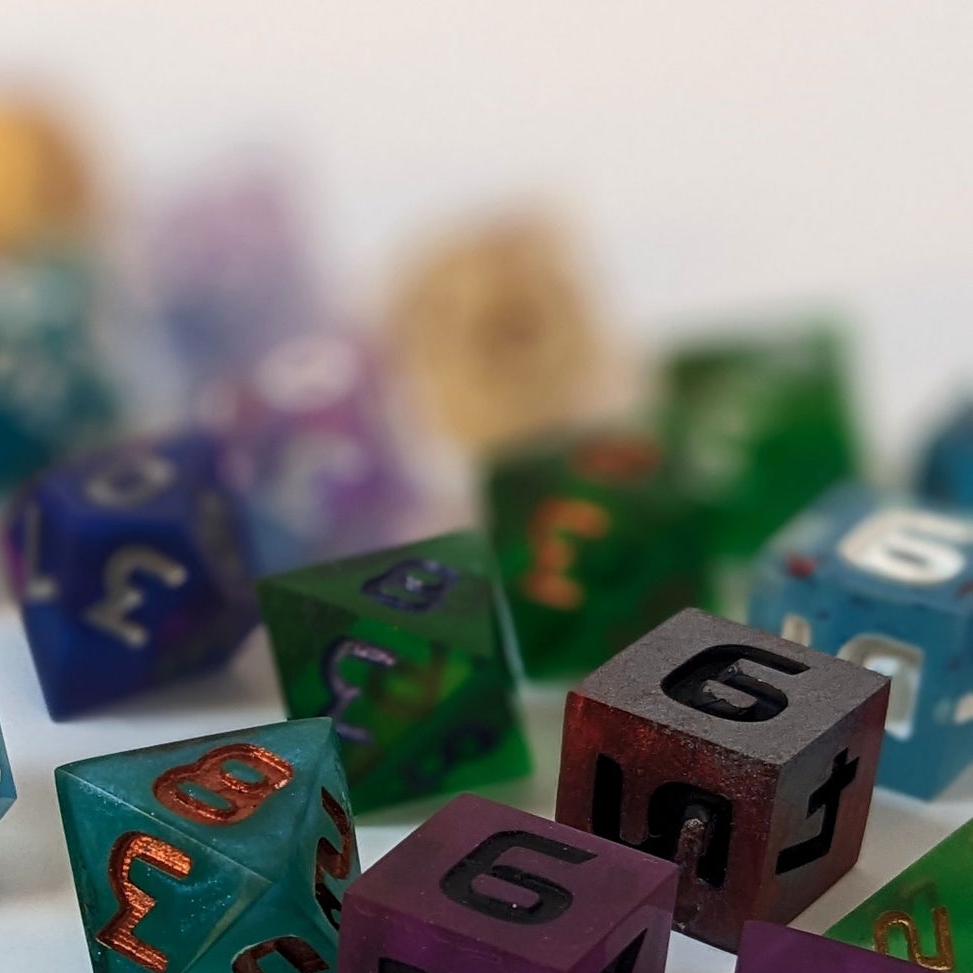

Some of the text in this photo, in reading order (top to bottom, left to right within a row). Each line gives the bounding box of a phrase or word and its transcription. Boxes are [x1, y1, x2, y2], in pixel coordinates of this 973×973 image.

[660, 643, 811, 723] 6
[152, 743, 295, 826] 8
[439, 829, 598, 926] 6
